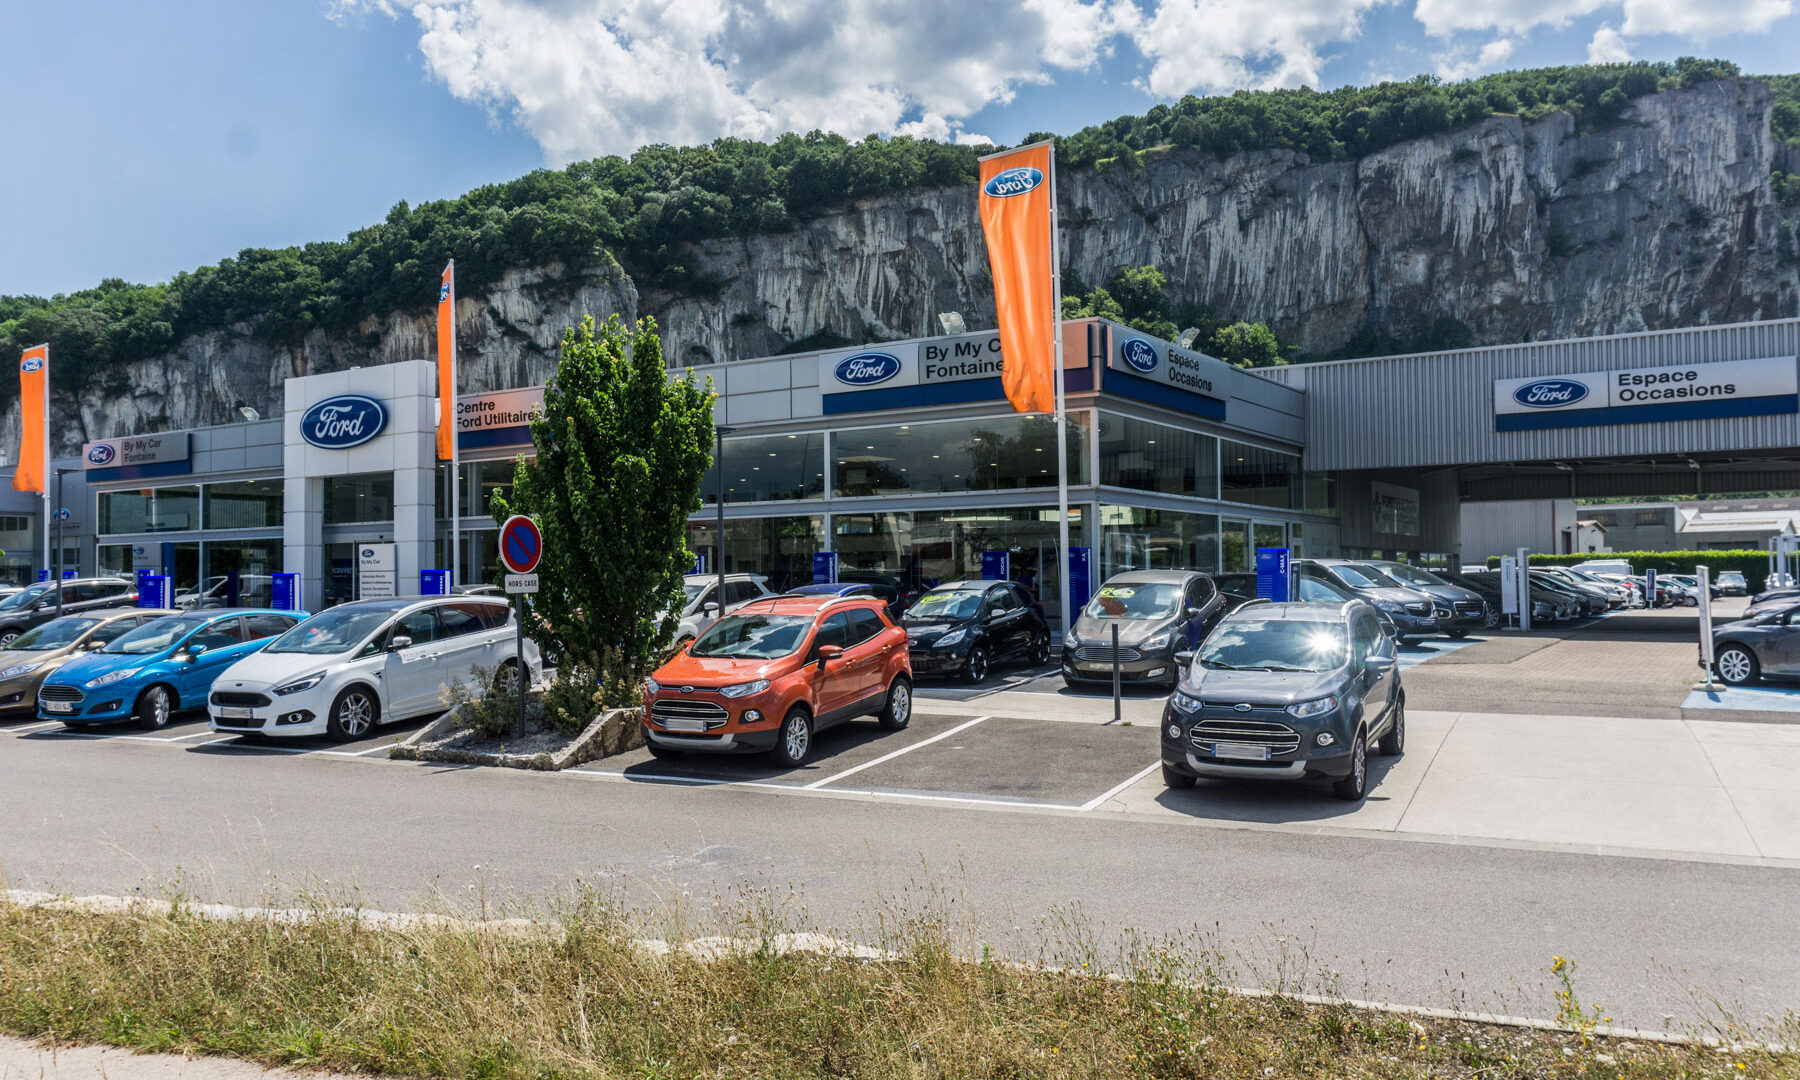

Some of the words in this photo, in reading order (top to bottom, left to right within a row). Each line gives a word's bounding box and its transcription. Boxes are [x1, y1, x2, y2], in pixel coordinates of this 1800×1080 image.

[926, 345, 949, 362] By
[954, 341, 982, 358] My
[1132, 342, 1153, 366] Ford
[1168, 349, 1199, 371] Espace
[846, 358, 886, 380] Ford
[926, 359, 1004, 379] Fontaine
[1168, 367, 1212, 392] Occasions
[1618, 370, 1698, 388] Espace
[1527, 384, 1572, 402] Ford
[1618, 384, 1737, 402] Occasions
[457, 400, 495, 414] Centre
[315, 405, 365, 438] Ford
[484, 410, 537, 425] Utilitaire
[124, 442, 135, 452] By
[135, 440, 148, 451] My
[148, 439, 162, 448] Car
[124, 452, 156, 462] Fontaine
